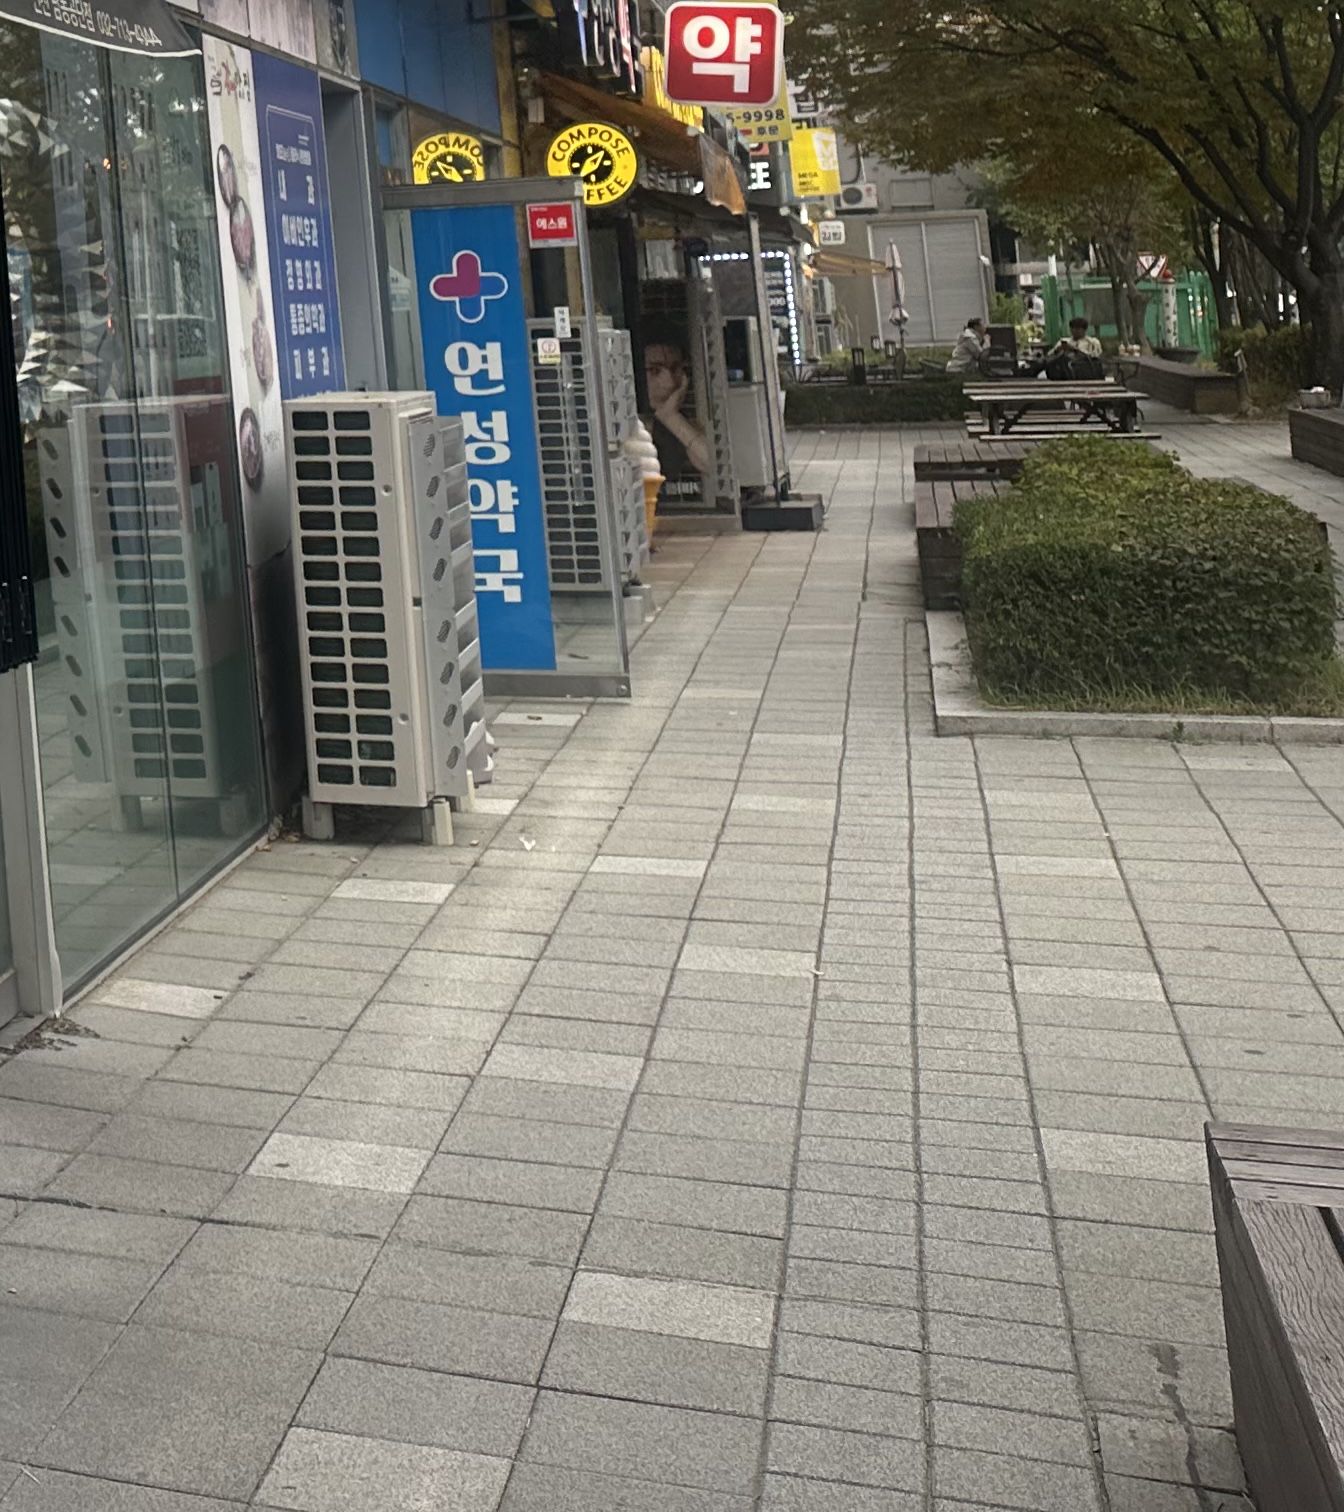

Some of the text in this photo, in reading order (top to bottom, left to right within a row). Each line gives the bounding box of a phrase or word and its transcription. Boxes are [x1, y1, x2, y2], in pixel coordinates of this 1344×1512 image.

[682, 14, 763, 95] 약
[552, 126, 631, 163] COMPOSE
[586, 174, 628, 202] FFEE
[444, 340, 525, 605] 연성약국
